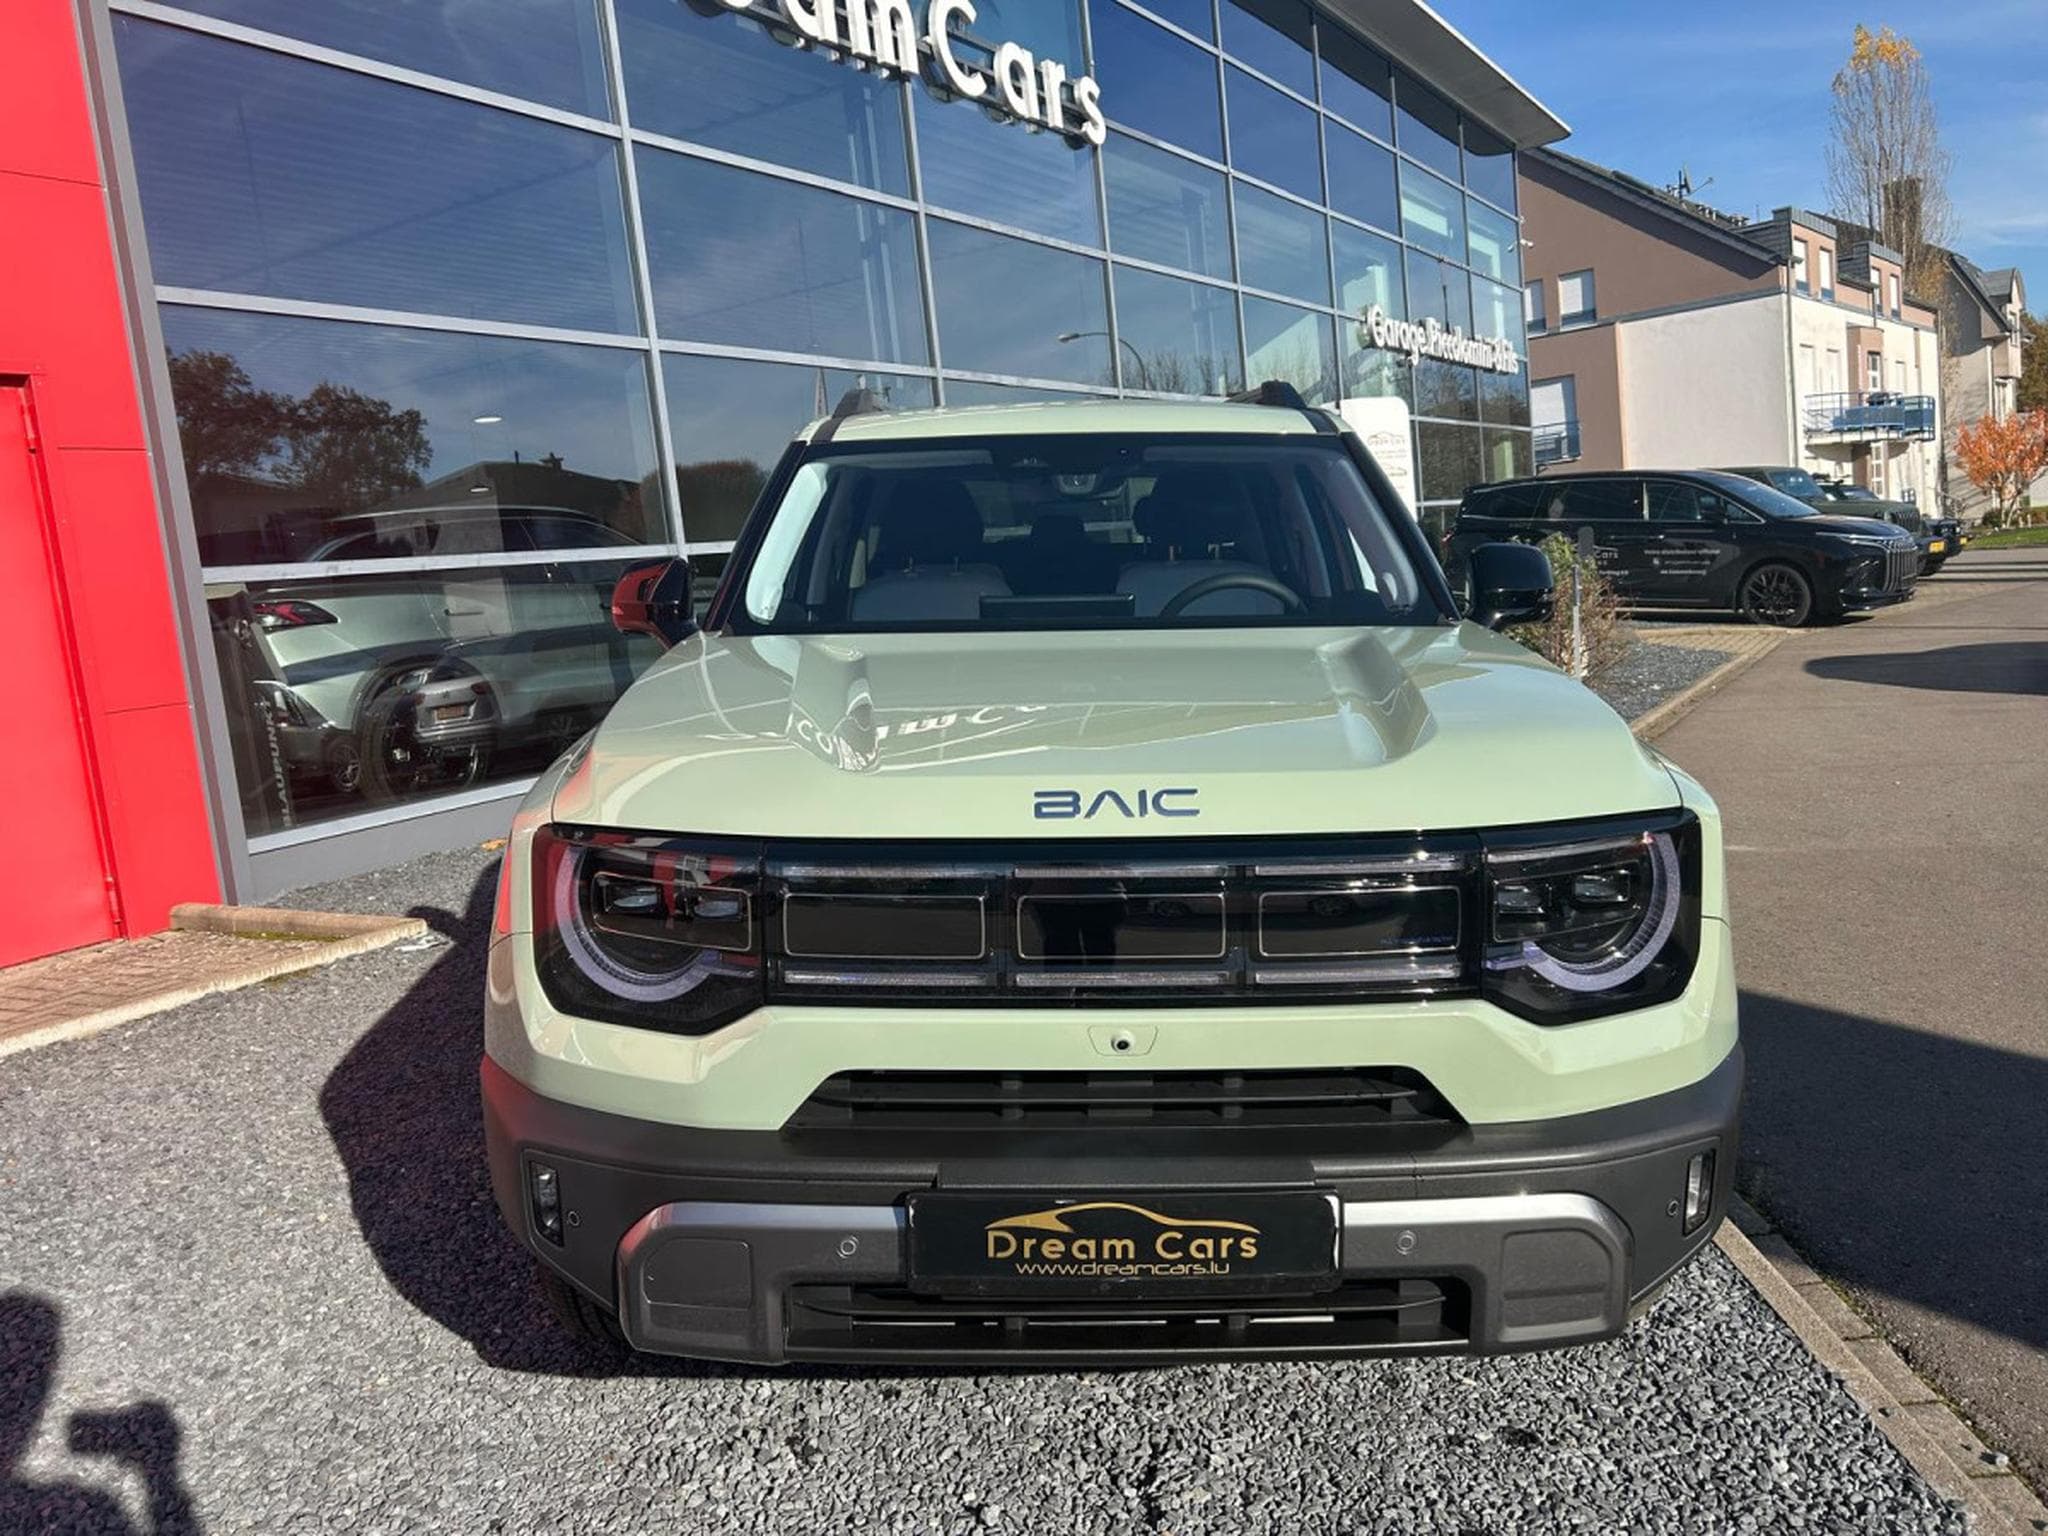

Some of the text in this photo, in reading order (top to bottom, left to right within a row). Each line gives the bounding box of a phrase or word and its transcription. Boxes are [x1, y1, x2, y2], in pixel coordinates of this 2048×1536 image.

[926, 0, 1107, 146] Cars
[1367, 304, 1427, 366] Garage
[1033, 788, 1200, 819] BAIC
[987, 1230, 1259, 1259] Dream Cars
[1015, 1262, 1230, 1276] www.dreamcars.lu
